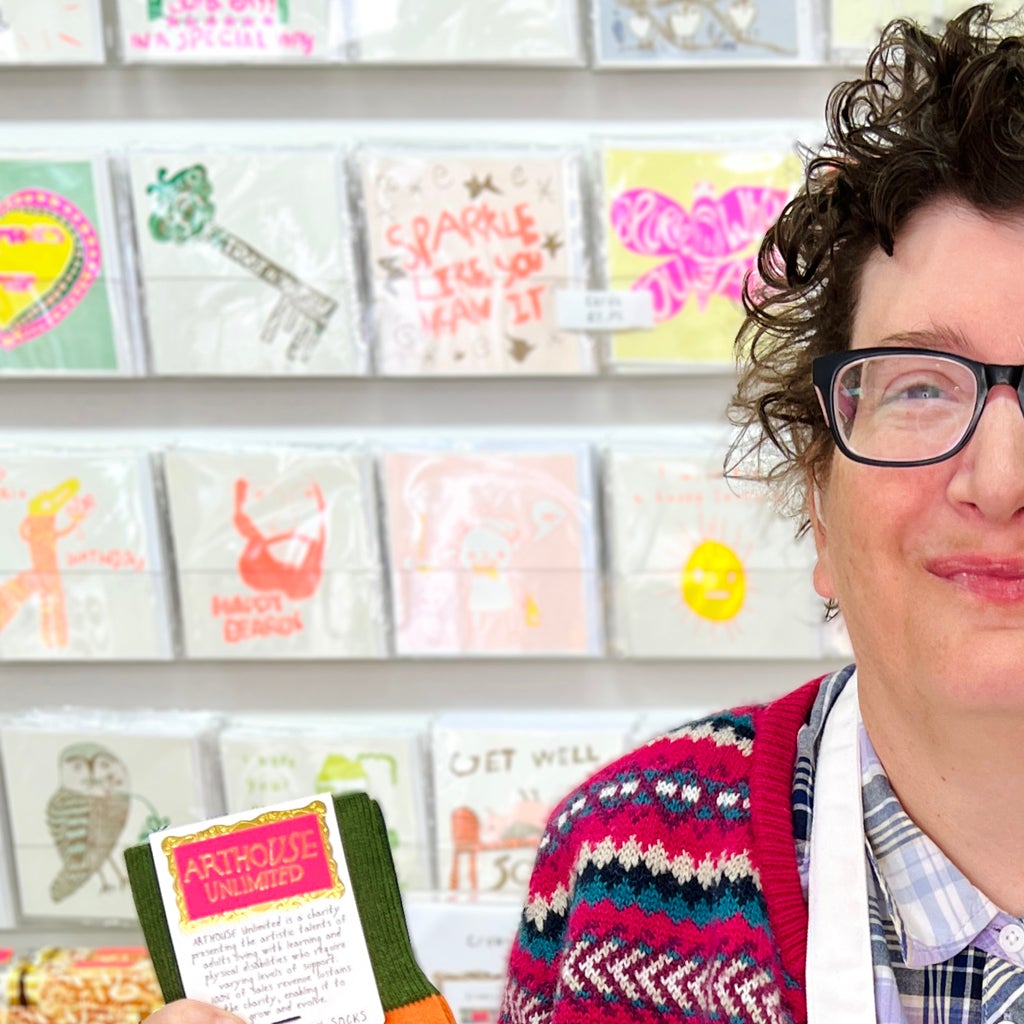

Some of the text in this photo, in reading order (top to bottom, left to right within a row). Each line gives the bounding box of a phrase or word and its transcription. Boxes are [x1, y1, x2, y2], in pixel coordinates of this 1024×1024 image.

[386, 202, 540, 270] SPARKLE
[413, 250, 544, 301] LIKE YOU
[506, 286, 546, 326] IT
[450, 746, 600, 778] GET WELL
[183, 830, 319, 885] ARTHOUSE
[204, 864, 304, 903] UNLIMITED
[191, 914, 345, 966] presenting the artistic talents of
[193, 929, 236, 946] ARTHOUSE
[241, 915, 281, 935] Unlimited
[307, 904, 340, 919] charity
[203, 955, 231, 970] adults
[261, 941, 282, 955] with
[287, 936, 323, 953] learning
[326, 926, 341, 941] and
[205, 965, 239, 987] physical
[292, 948, 310, 960] who
[219, 977, 255, 992] varying
[258, 968, 282, 981] levels
[287, 963, 296, 975] of
[235, 988, 245, 999] of
[277, 976, 312, 989] revenue
[284, 986, 319, 1000] enabling
[321, 981, 328, 991] it
[334, 978, 346, 988] to
[276, 1000, 291, 1014] and
